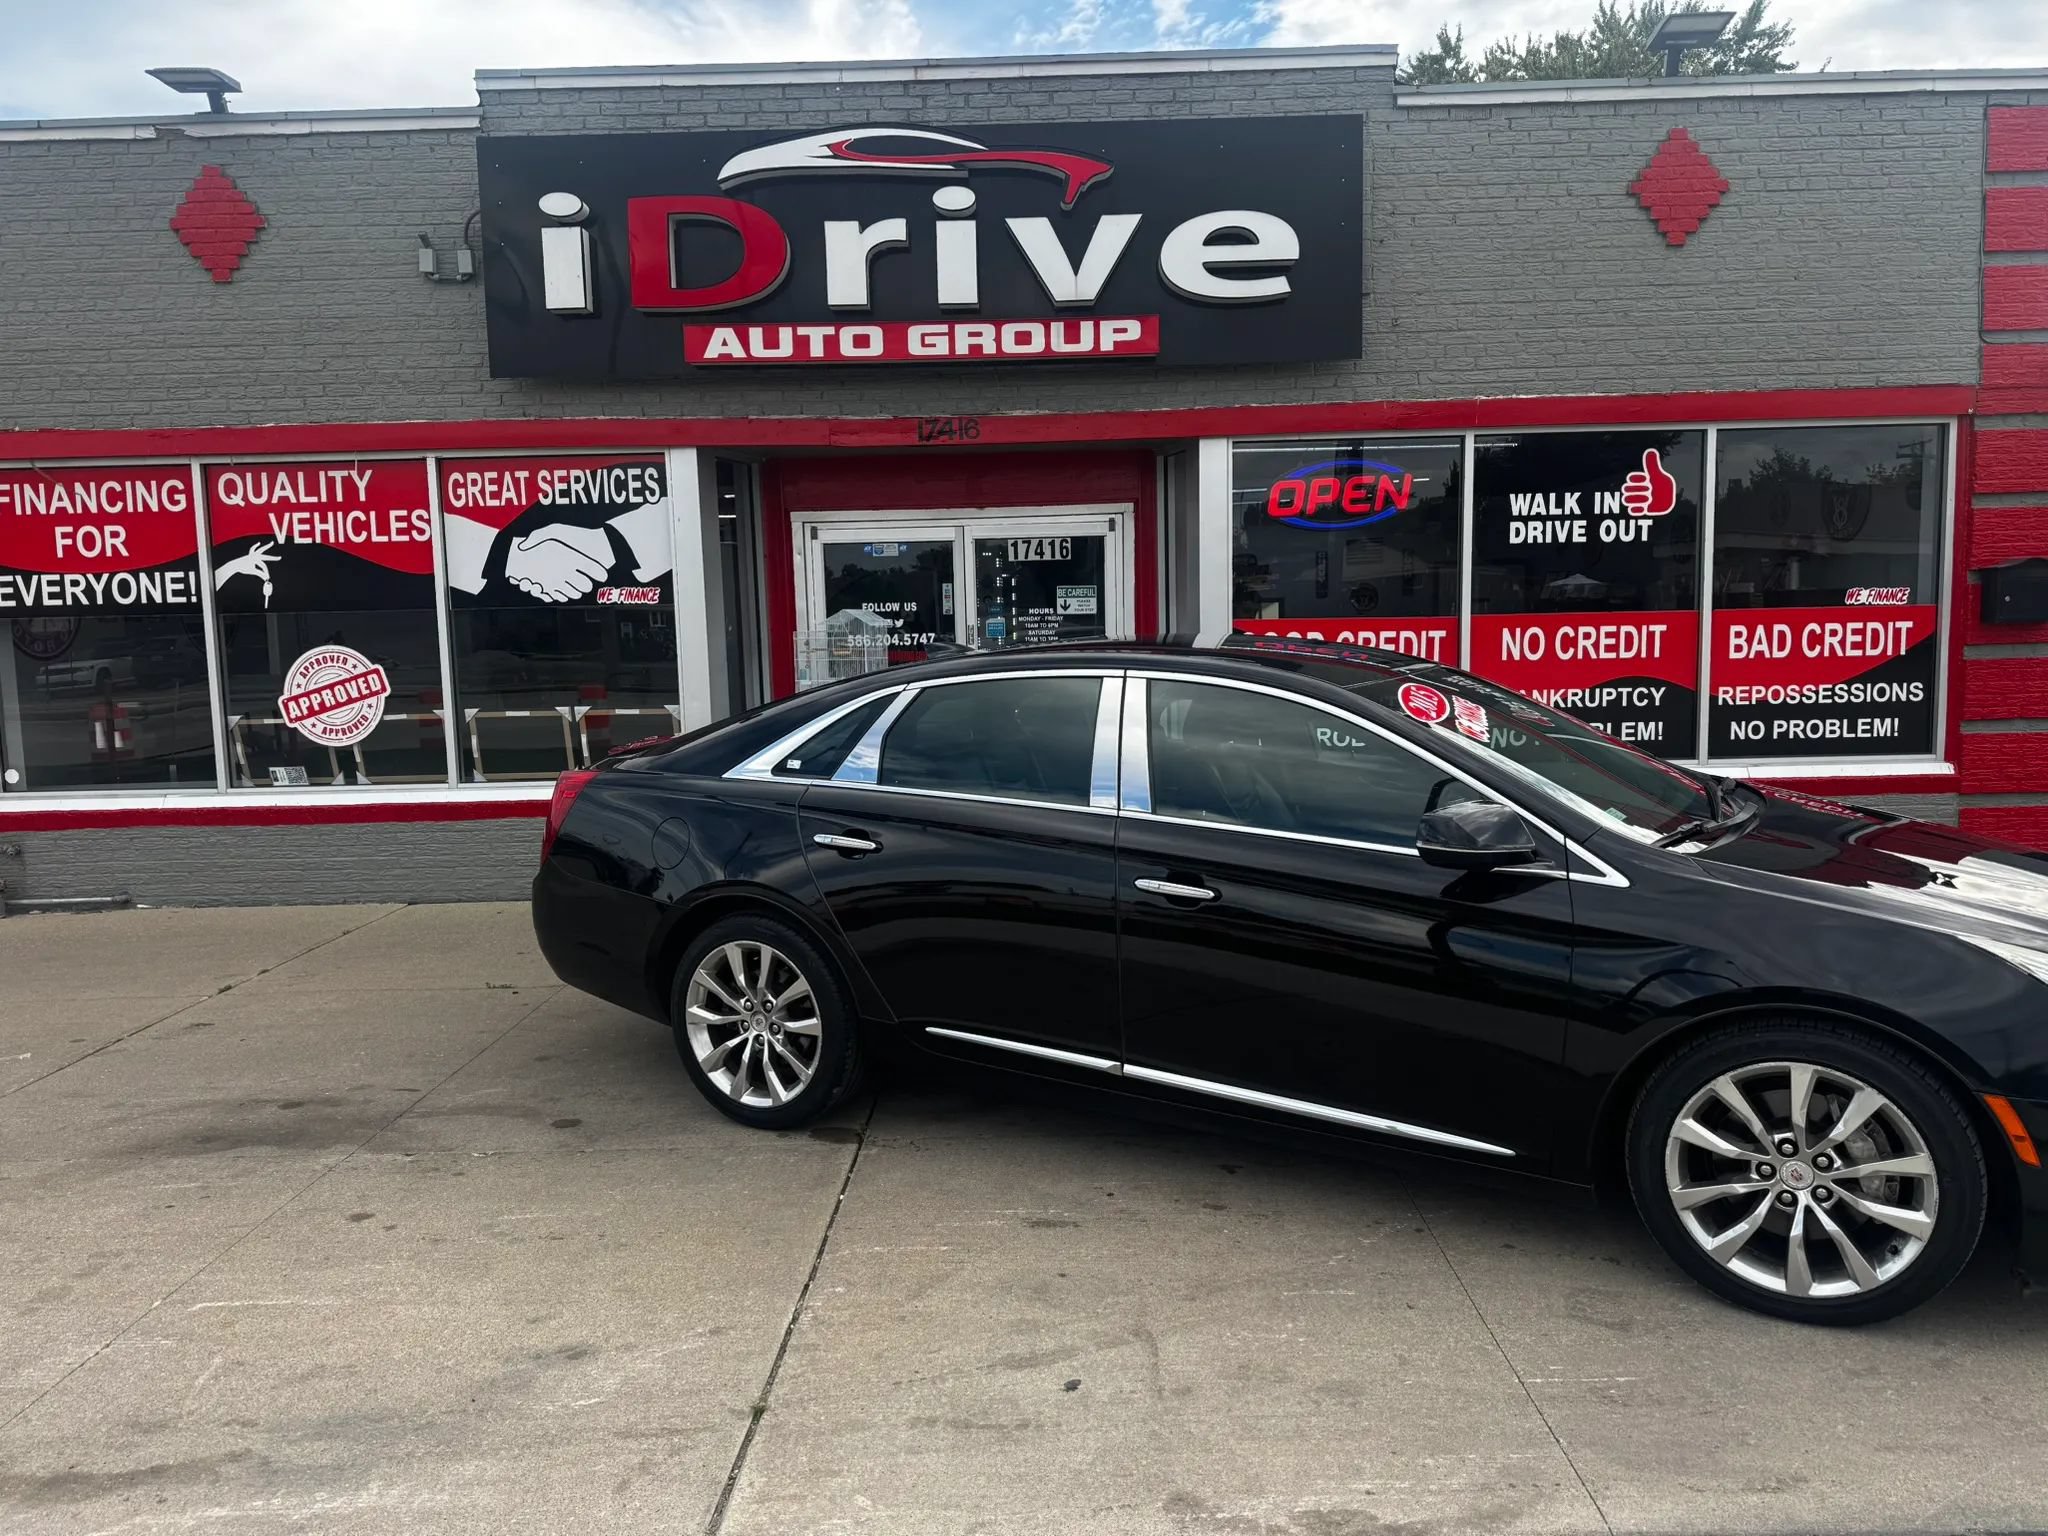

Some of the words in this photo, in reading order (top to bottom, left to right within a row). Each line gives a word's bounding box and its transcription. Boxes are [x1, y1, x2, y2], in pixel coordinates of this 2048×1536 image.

[538, 186, 1301, 313] iDrive
[703, 326, 884, 358] AUTO
[907, 320, 1142, 355] GROUP
[218, 469, 373, 507] QUALITY
[448, 470, 530, 508] GREAT
[537, 467, 660, 505] SERVICES
[1268, 473, 1413, 517] OPEN
[1509, 492, 1582, 516] WALK
[1594, 491, 1621, 515] IN
[55, 525, 129, 558] FOR
[268, 509, 431, 545] VEHICLES
[1509, 520, 1587, 544] DRIVE
[1599, 519, 1653, 543] OUT
[1010, 538, 1070, 560] 17416
[0, 571, 198, 607] EVERYONE!
[597, 588, 615, 603] WE
[617, 587, 660, 603] FINANCE
[1846, 588, 1863, 604] WE
[1865, 587, 1910, 604] FINANCE
[862, 602, 900, 612] FOLLOW
[904, 602, 917, 611] US
[1028, 607, 1054, 615] HOURS
[1501, 626, 1546, 661] NO
[1554, 624, 1667, 660] CREDIT
[1728, 623, 1792, 659] BAD
[1801, 620, 1913, 658] CREDIT
[299, 654, 349, 680] APPROVED
[286, 673, 382, 720] APPROVED
[1717, 681, 1924, 706] REPOSSESSIONS
[320, 714, 369, 737] APPROVED
[1729, 720, 1765, 740] NO
[1772, 717, 1900, 740] PROBLEM!
